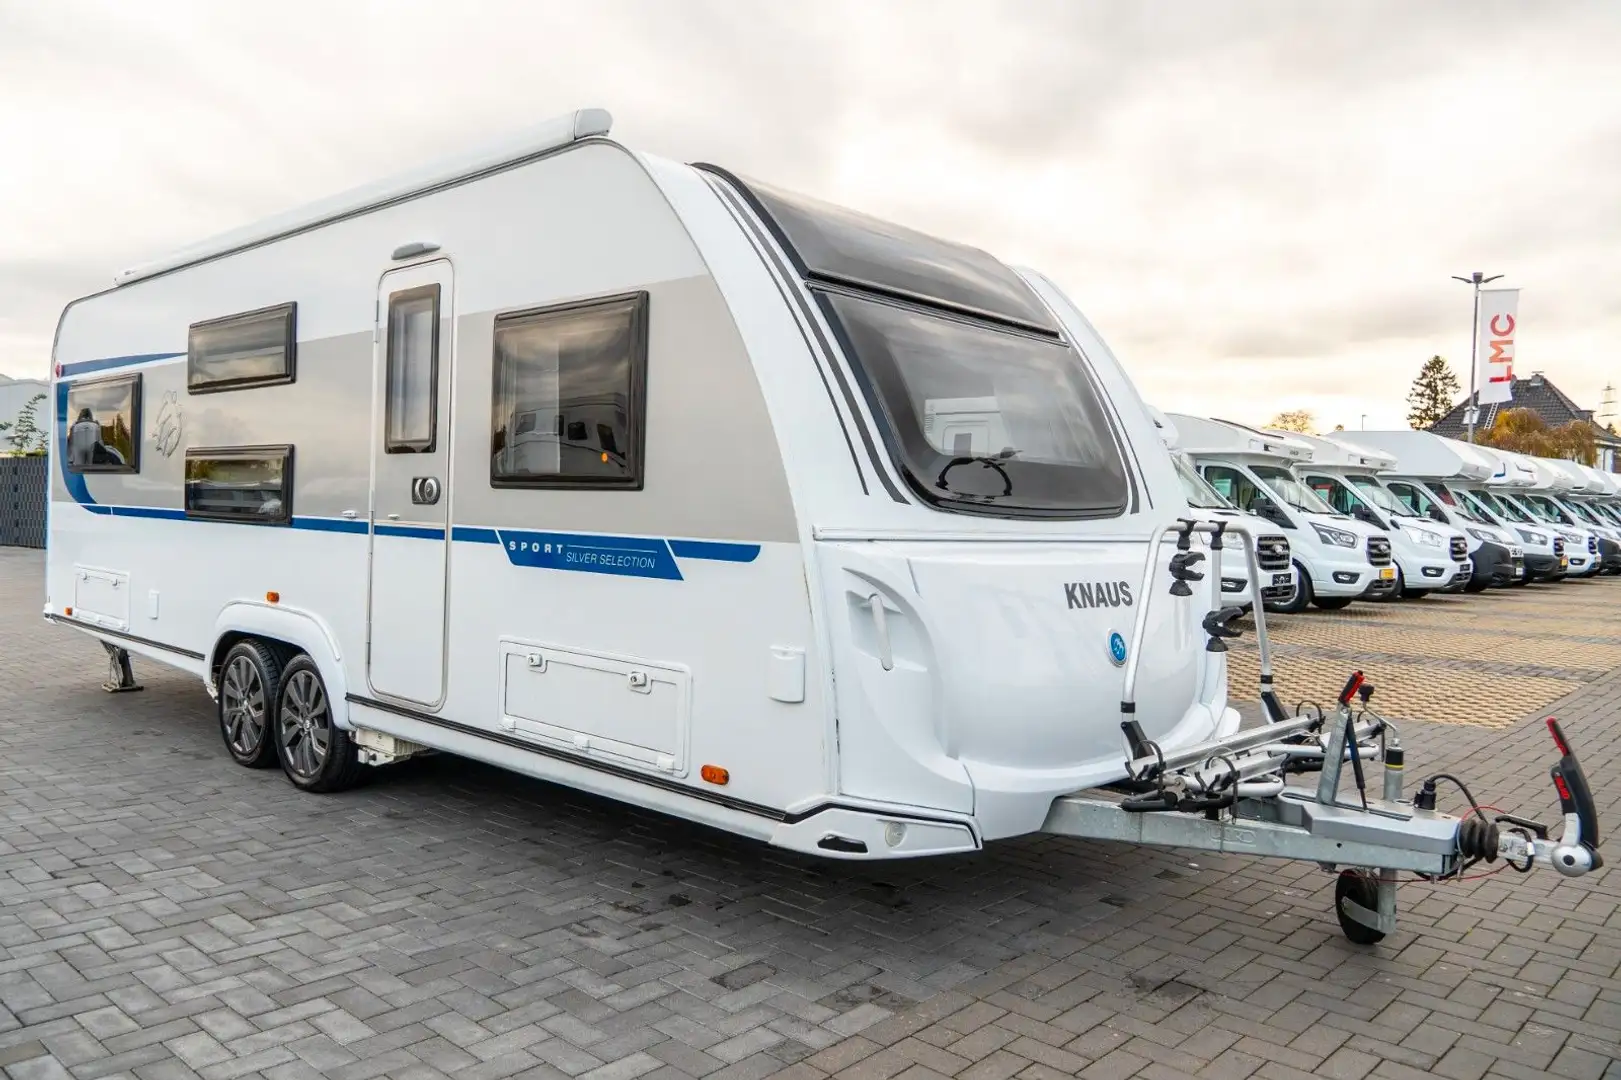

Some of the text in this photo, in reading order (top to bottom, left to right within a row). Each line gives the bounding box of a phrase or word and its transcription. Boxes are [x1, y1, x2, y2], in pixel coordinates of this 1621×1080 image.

[1489, 314, 1515, 383] LMC
[509, 541, 563, 554] SPORT
[566, 552, 656, 569] SILVER SELECTION
[1063, 581, 1133, 609] KNAUS
